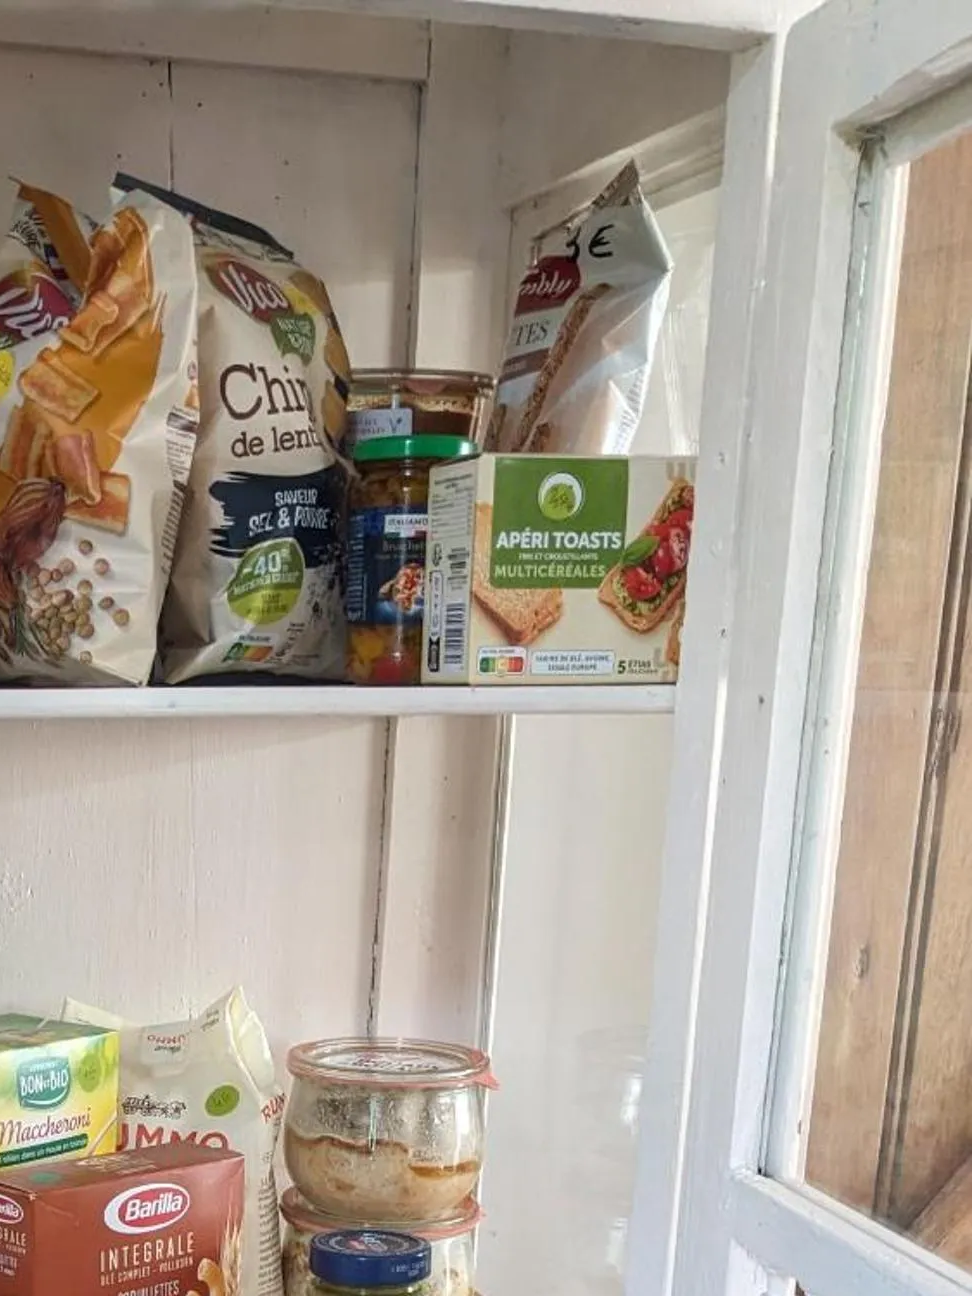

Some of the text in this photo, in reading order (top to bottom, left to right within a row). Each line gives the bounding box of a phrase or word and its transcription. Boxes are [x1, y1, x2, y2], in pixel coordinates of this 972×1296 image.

[219, 262, 289, 314] Vico
[513, 318, 552, 347] TES
[231, 430, 265, 458] de
[274, 488, 319, 507] SAVEUR
[248, 512, 274, 537] SEL
[277, 507, 291, 529] &
[496, 526, 622, 549] APÉRI TOASTS
[494, 562, 607, 579] MULTICÉRÉALES
[617, 659, 626, 675] 5
[20, 1073, 44, 1098] BON
[50, 1068, 69, 1093] BIO
[124, 1191, 184, 1222] Barilla
[100, 1232, 195, 1273] INTEGRALE
